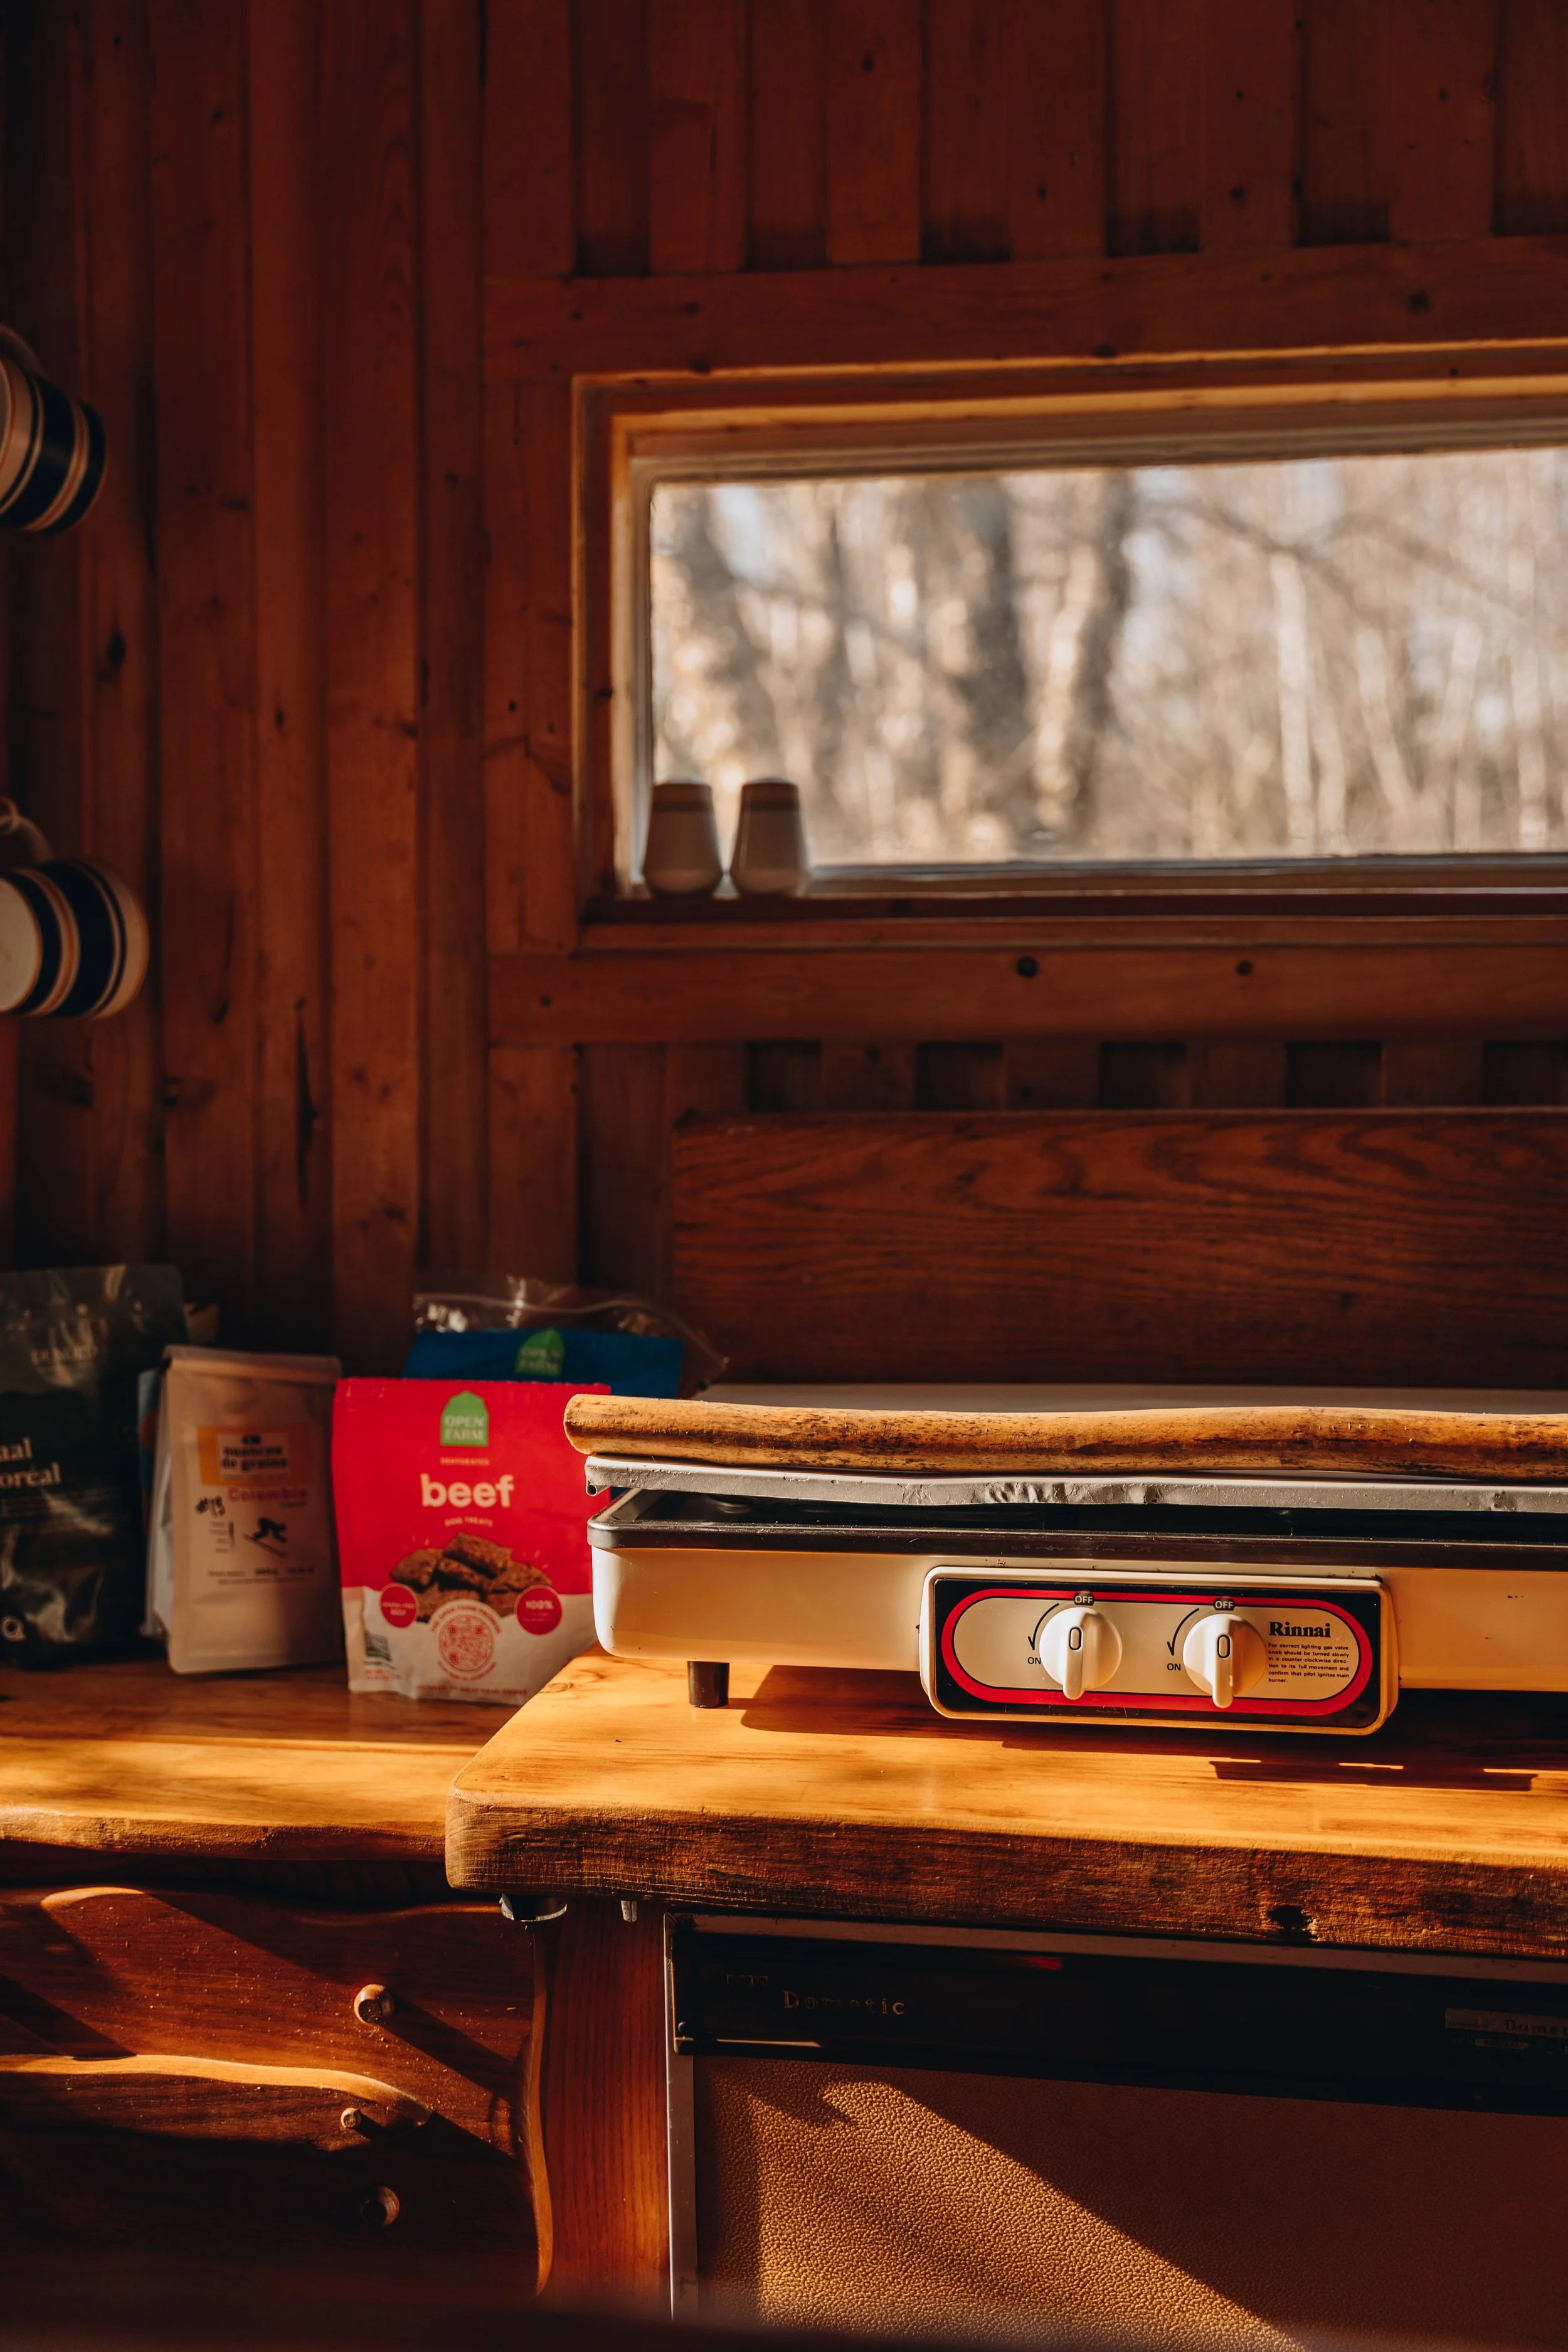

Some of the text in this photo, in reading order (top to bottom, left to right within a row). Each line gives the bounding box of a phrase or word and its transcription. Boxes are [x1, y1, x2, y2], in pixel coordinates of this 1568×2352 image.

[445, 1415, 484, 1426] OPEN
[445, 1429, 484, 1441] FARM
[420, 1474, 515, 1507] beef
[445, 1516, 493, 1527] DOG TREATS
[525, 1599, 554, 1610] 100%
[1074, 1596, 1093, 1604] OFF
[1269, 1622, 1331, 1638] Rinnai
